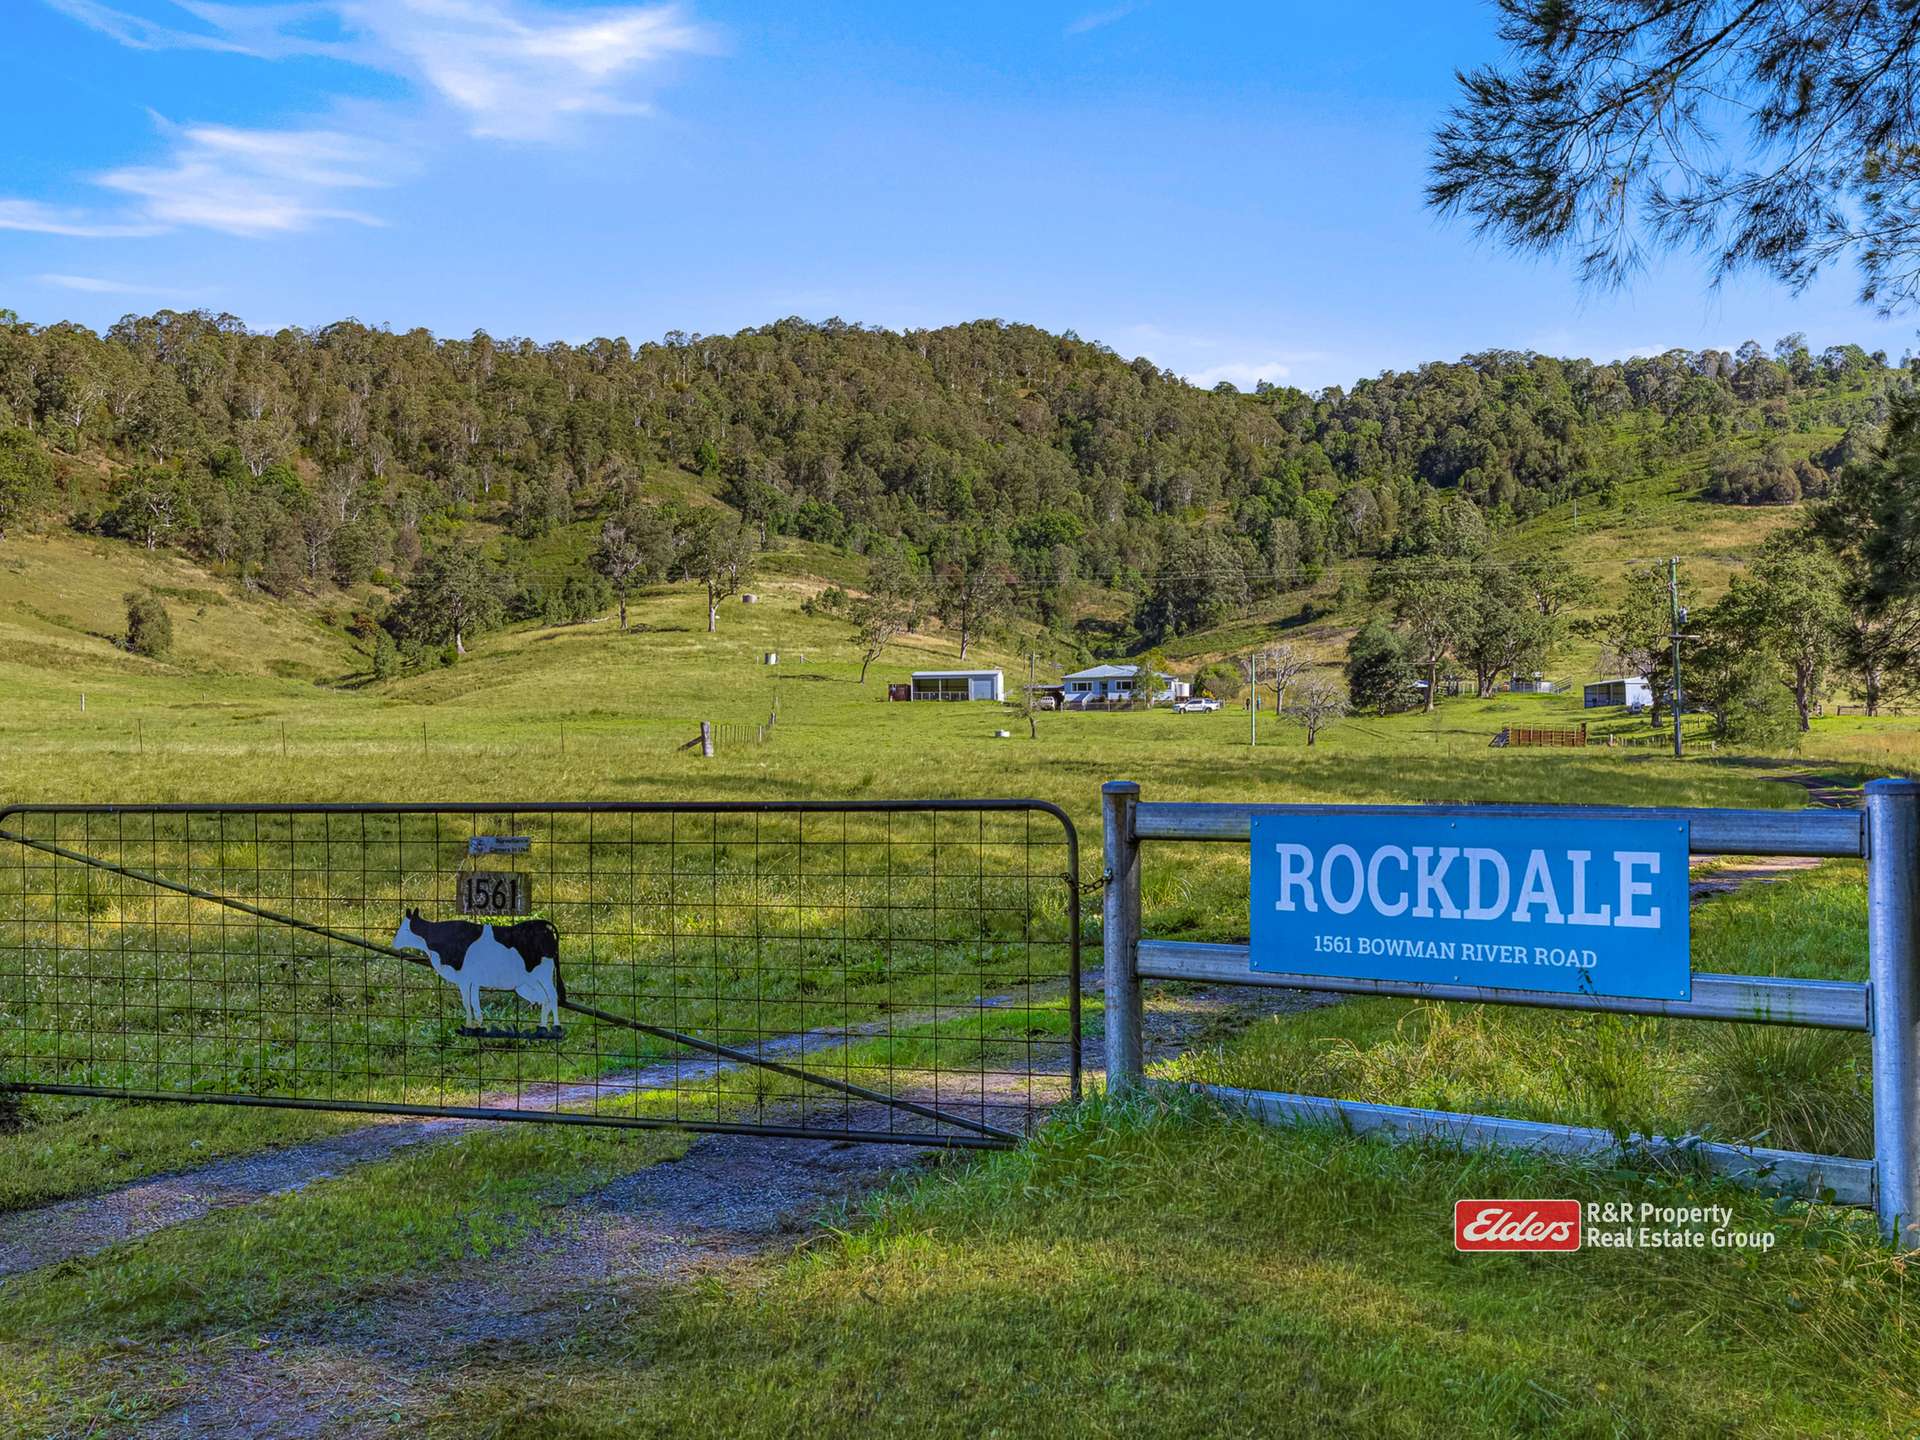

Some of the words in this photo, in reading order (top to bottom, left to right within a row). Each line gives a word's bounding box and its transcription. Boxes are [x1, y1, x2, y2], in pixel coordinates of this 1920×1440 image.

[467, 878, 516, 909] 1561
[1275, 843, 1661, 928] ROCKDALE
[1314, 936, 1353, 954] 1561
[1358, 938, 1456, 960] BOWMAN
[1461, 943, 1529, 964] RIVER
[1534, 948, 1598, 968] ROAD
